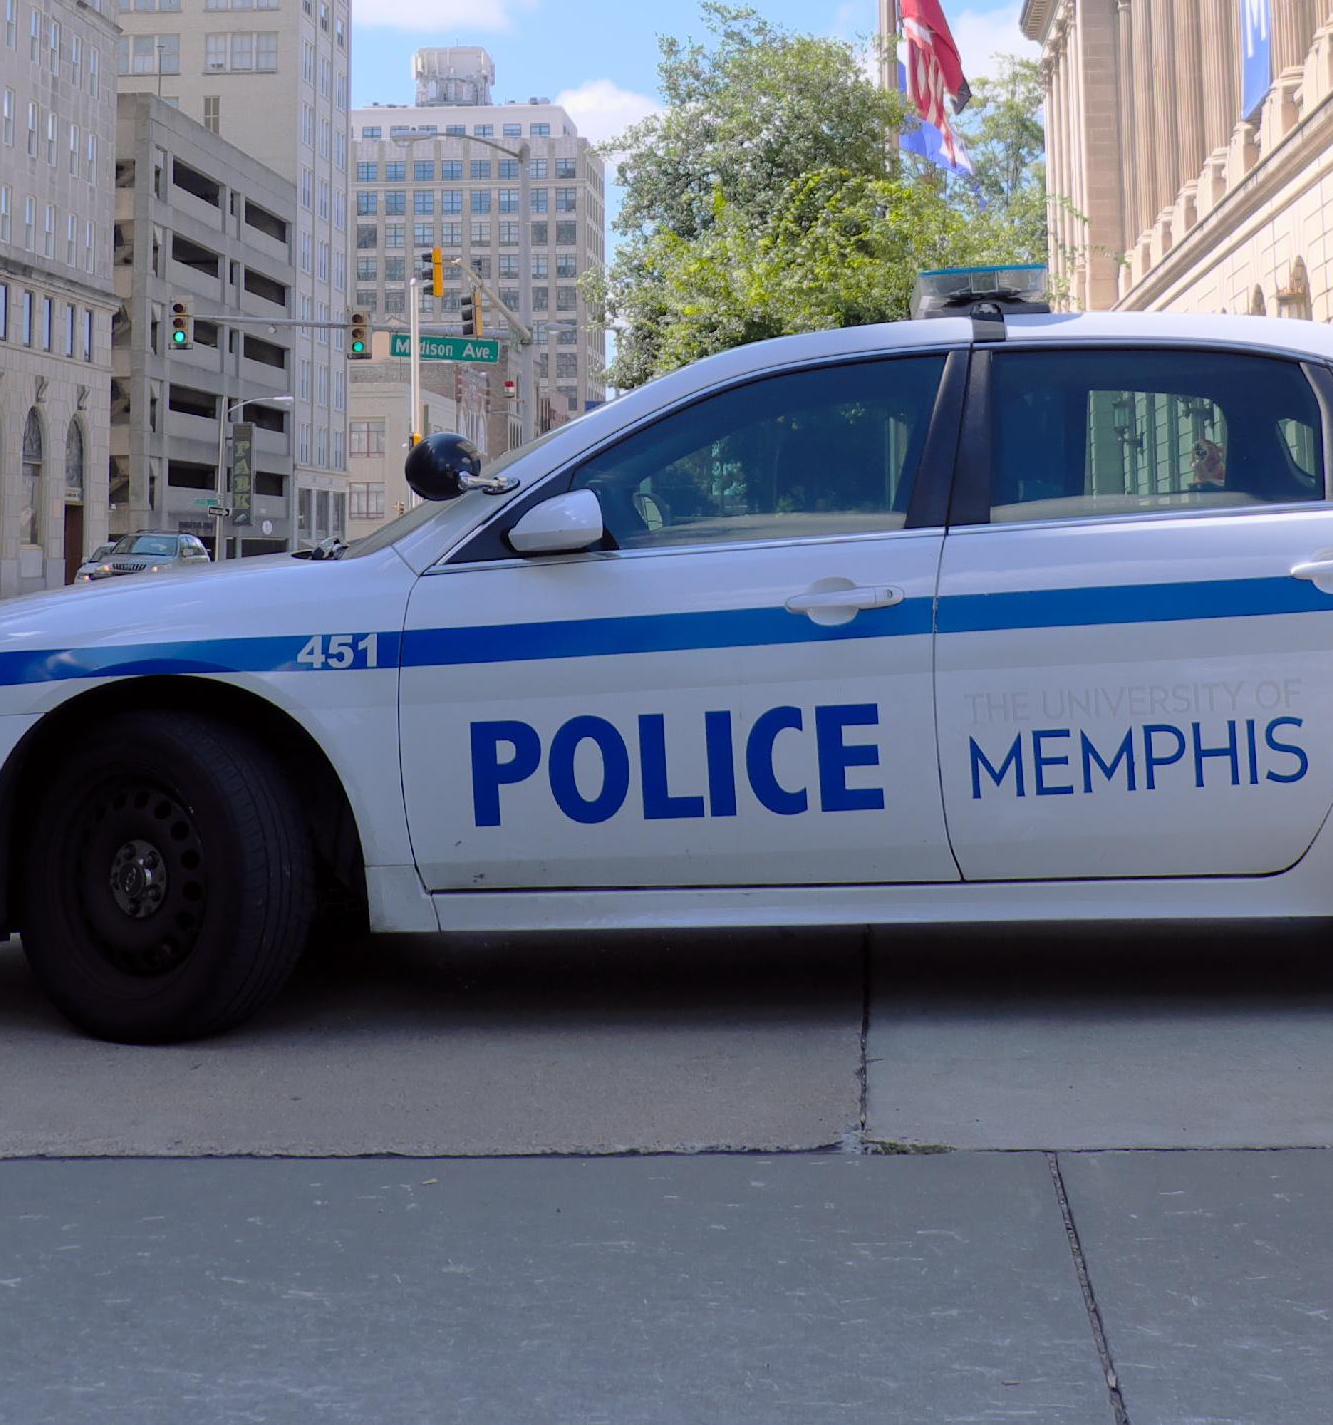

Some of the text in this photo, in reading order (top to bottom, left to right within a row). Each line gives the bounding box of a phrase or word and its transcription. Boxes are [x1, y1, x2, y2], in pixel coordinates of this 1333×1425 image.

[395, 338, 494, 359] Mdison Ave.
[297, 633, 378, 669] 451
[964, 677, 1302, 725] THE UNIVERSITY OF
[469, 702, 886, 827] POLICE
[969, 716, 1309, 799] MEMPHIS
